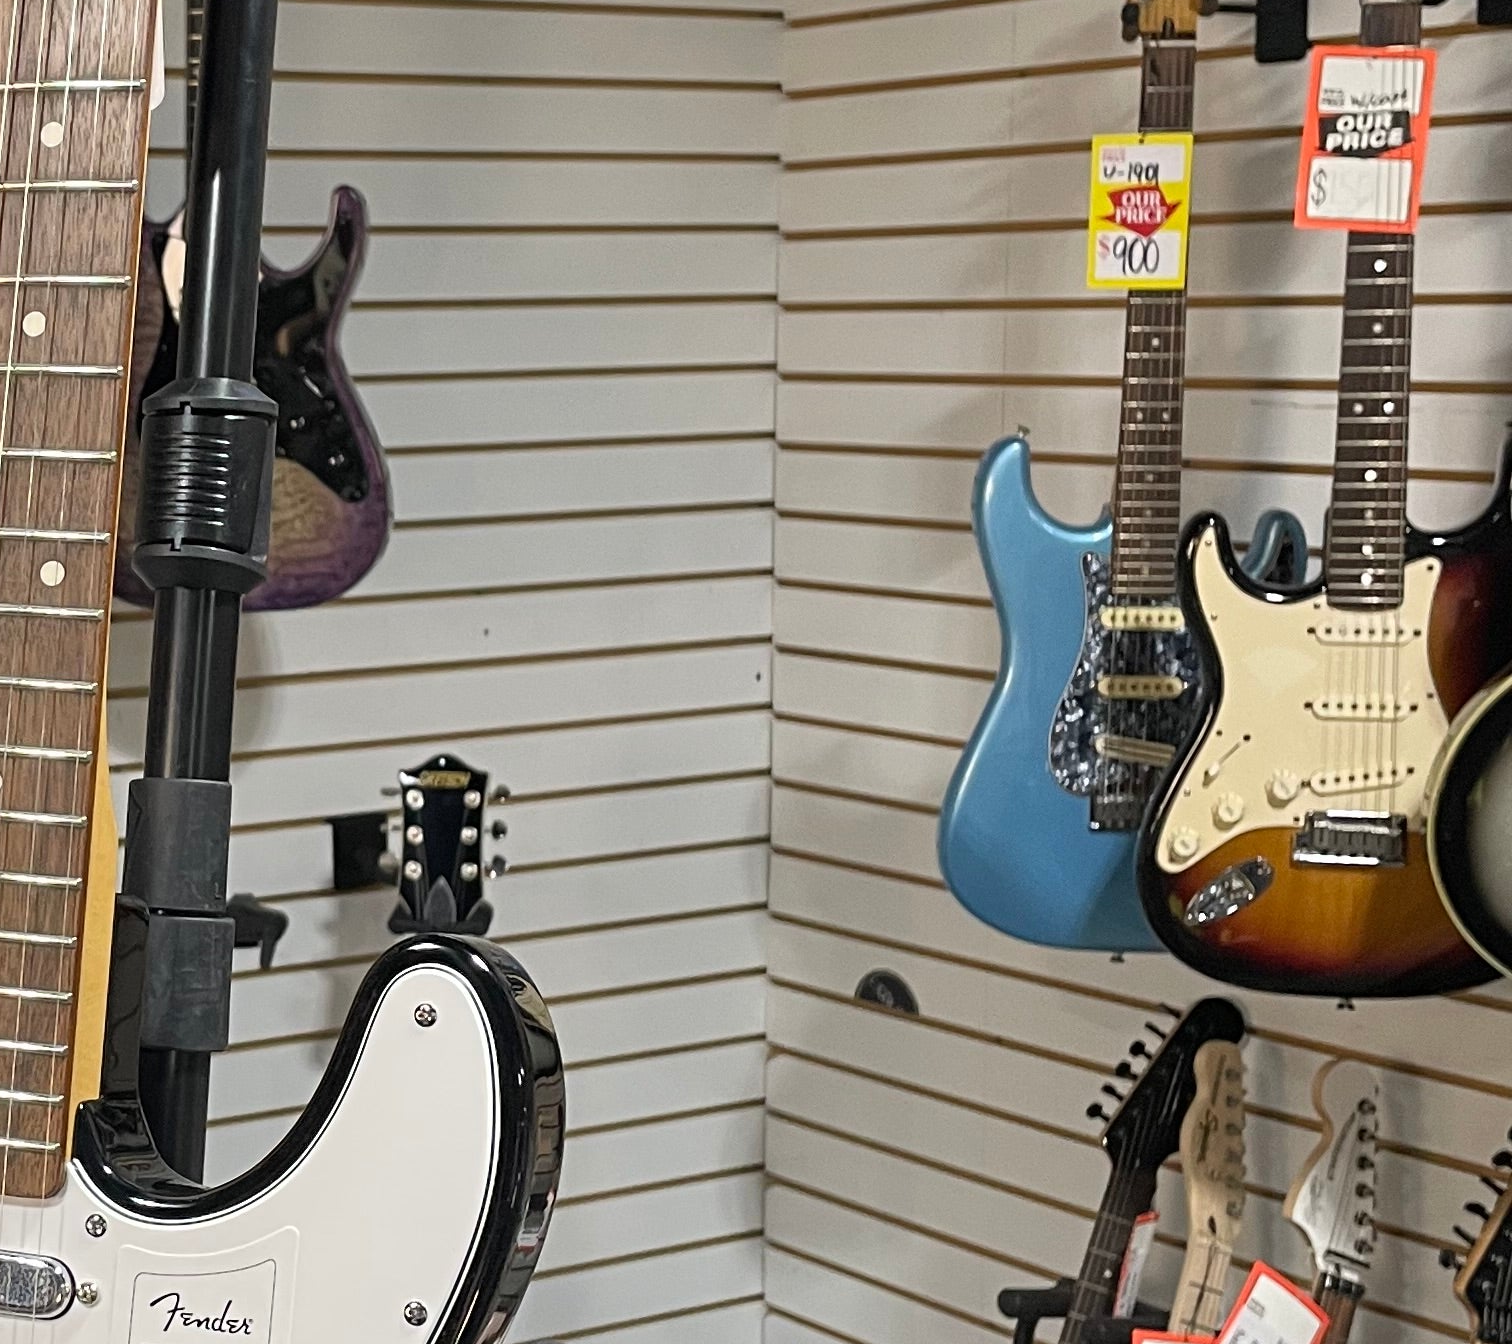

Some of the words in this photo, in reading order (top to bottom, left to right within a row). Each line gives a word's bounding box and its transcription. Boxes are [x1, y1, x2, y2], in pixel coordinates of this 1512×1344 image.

[1336, 113, 1393, 132] OUR
[1325, 127, 1405, 152] PRICE
[1120, 190, 1162, 209] OUR
[1114, 205, 1166, 225] PRICE
[1097, 234, 1160, 276] $900
[149, 1292, 254, 1335] Fender
